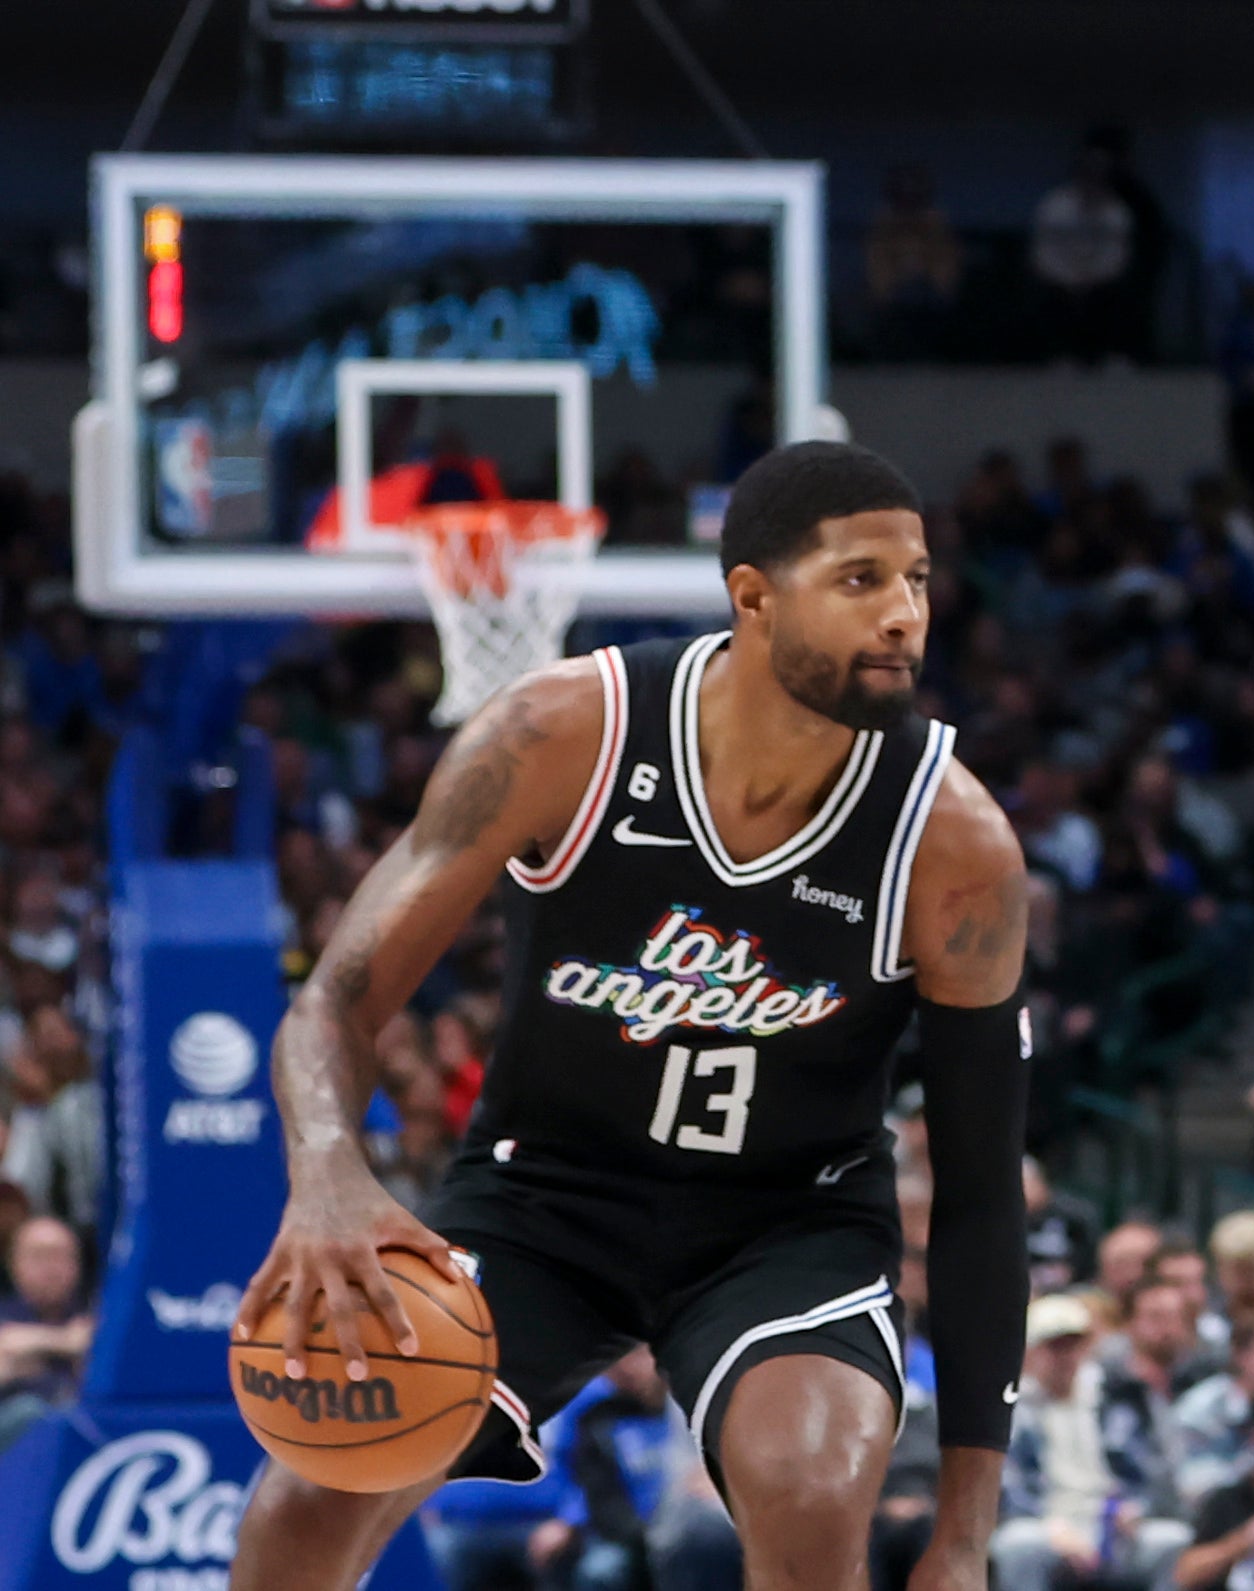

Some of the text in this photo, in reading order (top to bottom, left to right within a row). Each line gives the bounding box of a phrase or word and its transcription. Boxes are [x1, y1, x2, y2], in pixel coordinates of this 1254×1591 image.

[628, 762, 660, 801] 6
[791, 874, 865, 924] honey
[638, 908, 768, 984] los
[546, 960, 844, 1044] angeles
[648, 1043, 758, 1155] 13
